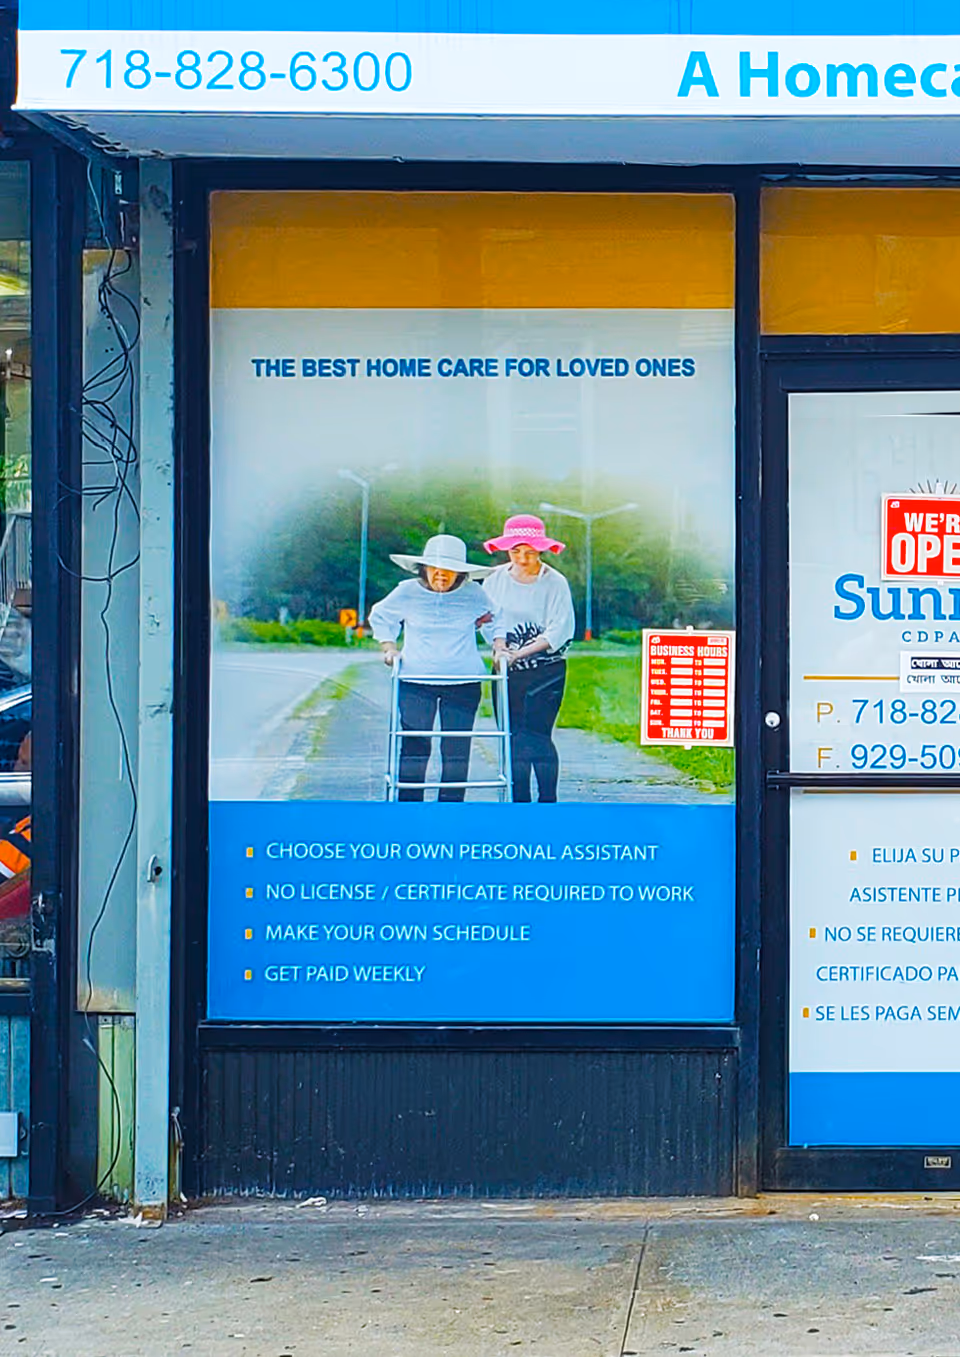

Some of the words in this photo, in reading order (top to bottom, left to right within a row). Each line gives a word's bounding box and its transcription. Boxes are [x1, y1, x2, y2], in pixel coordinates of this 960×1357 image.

[60, 49, 412, 92] 718-828-6300
[677, 51, 719, 97] A
[251, 358, 296, 378] THE
[301, 358, 361, 378] BEST
[366, 358, 432, 378] HOME
[437, 358, 499, 378] CARE
[504, 357, 551, 378] FOR
[556, 357, 630, 377] LOVED
[635, 358, 696, 377] ONES
[650, 646, 694, 656] BUSINESS
[697, 647, 728, 657] HOURS
[816, 702, 841, 723] P.
[661, 727, 693, 739] THANK
[695, 728, 715, 739] YOU
[817, 747, 840, 769] F.
[266, 842, 345, 859] CHOOSE
[349, 843, 401, 859] YOUR
[406, 843, 454, 859] OWN
[459, 843, 556, 860] PERSONAL
[561, 844, 659, 861] ASSISTANT
[872, 847, 917, 864] ELIJA
[921, 847, 944, 864] SU
[266, 883, 295, 900] NO
[300, 883, 376, 900] LICENSE
[394, 884, 508, 900] CERTIFICATE
[513, 884, 604, 901] REQUIRED
[609, 885, 633, 900] TO
[638, 885, 694, 901] WORK
[849, 886, 942, 903] ASISTENTE
[266, 924, 319, 941] MAKE
[323, 924, 375, 941] YOUR
[379, 924, 427, 941] OWN
[432, 925, 530, 941] SCHEDULE
[824, 926, 852, 943] NO
[856, 926, 877, 942] SE
[264, 965, 302, 981] GET
[306, 965, 349, 982] PAID
[353, 965, 426, 982] WEEKLY
[815, 965, 933, 982] CERTIFICADO
[815, 1005, 836, 1022] SE
[840, 1005, 870, 1021] LES
[875, 1005, 922, 1022] PAGA
